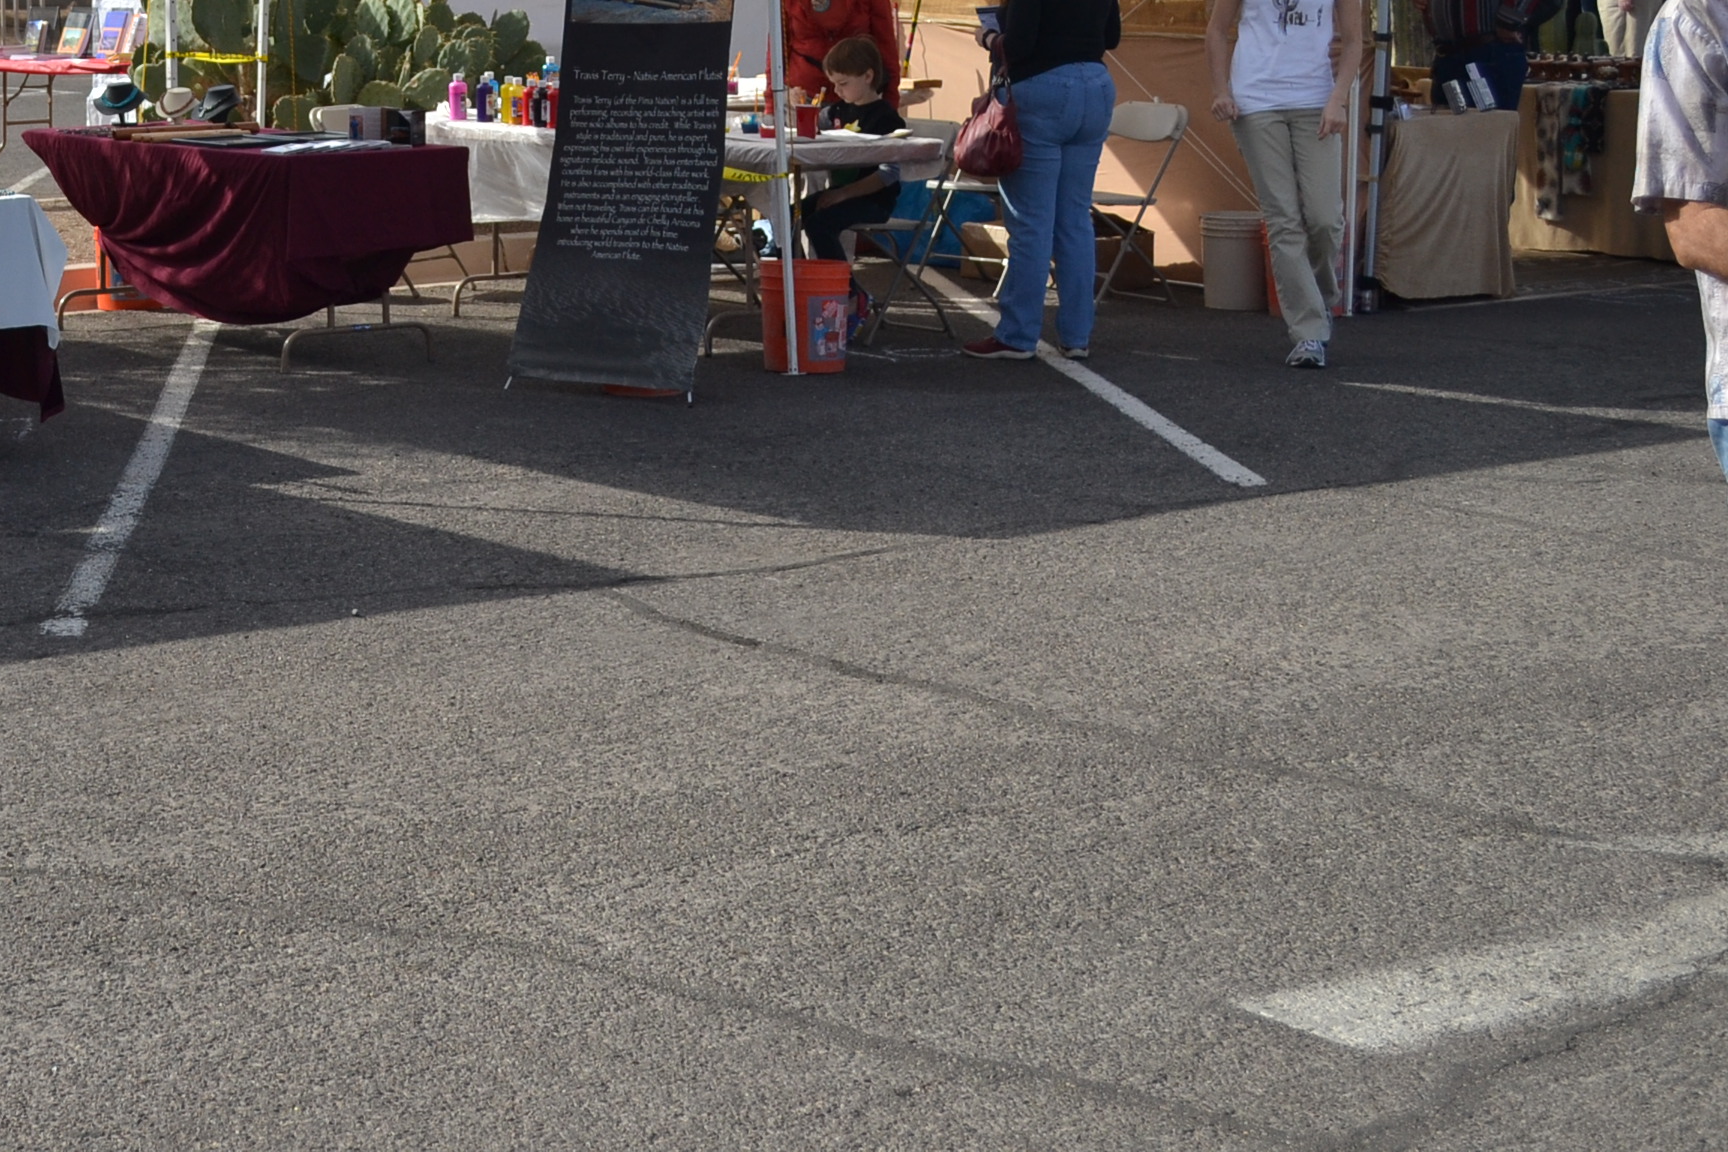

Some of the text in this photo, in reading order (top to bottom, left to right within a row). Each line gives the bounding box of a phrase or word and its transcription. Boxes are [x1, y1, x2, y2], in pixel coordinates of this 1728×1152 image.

[573, 68, 599, 80] Travis
[601, 69, 626, 86] Terry
[633, 70, 658, 81] Native
[660, 70, 697, 81] American
[699, 67, 723, 80] Flutist
[574, 95, 593, 104] Travis
[594, 95, 612, 108] Terry
[625, 94, 637, 105] the
[693, 93, 705, 105] full
[706, 97, 719, 105] time
[610, 106, 642, 120] recording
[642, 106, 656, 117] and
[657, 106, 686, 119] teaching
[687, 109, 705, 117] artist
[706, 106, 719, 117] with
[571, 117, 588, 128] three
[589, 117, 604, 128] solo
[605, 117, 628, 129] albums
[674, 117, 692, 129] While
[576, 129, 592, 143] style
[600, 129, 635, 141] traditional
[635, 129, 648, 141] and
[684, 133, 707, 146] expert
[563, 145, 599, 156] expressing
[600, 141, 610, 152] his
[636, 146, 677, 159] experiences
[677, 143, 706, 158] through
[707, 143, 717, 154] his
[560, 156, 590, 167] signature
[591, 153, 616, 164] melodic
[644, 155, 662, 165] Travis
[663, 154, 676, 165] has
[676, 155, 718, 167] entertained
[562, 165, 592, 176] countless
[593, 164, 609, 176] fans
[609, 165, 623, 176] with
[624, 165, 634, 176] his
[634, 166, 672, 178] world-class
[561, 179, 571, 188] He
[577, 177, 592, 188] also
[592, 177, 637, 193] accomplished
[637, 178, 652, 189] with
[652, 178, 671, 190] other
[672, 179, 709, 191] traditional
[631, 194, 661, 205] engaging
[557, 200, 574, 211] When
[574, 203, 587, 211] not
[619, 203, 637, 213] Travis
[637, 205, 651, 213] can
[660, 202, 684, 214] found
[692, 203, 704, 215] his
[556, 211, 574, 222] home
[581, 212, 611, 224] beautiful
[611, 215, 637, 228] Canyon
[671, 217, 701, 228] Arizona
[570, 224, 590, 235] where
[599, 225, 623, 239] spends
[624, 228, 640, 236] most
[650, 226, 661, 237] his
[662, 230, 679, 239] time
[593, 237, 613, 248] world
[612, 237, 641, 248] travelers
[651, 238, 665, 250] the
[665, 242, 689, 252] Native
[591, 250, 622, 259] American
